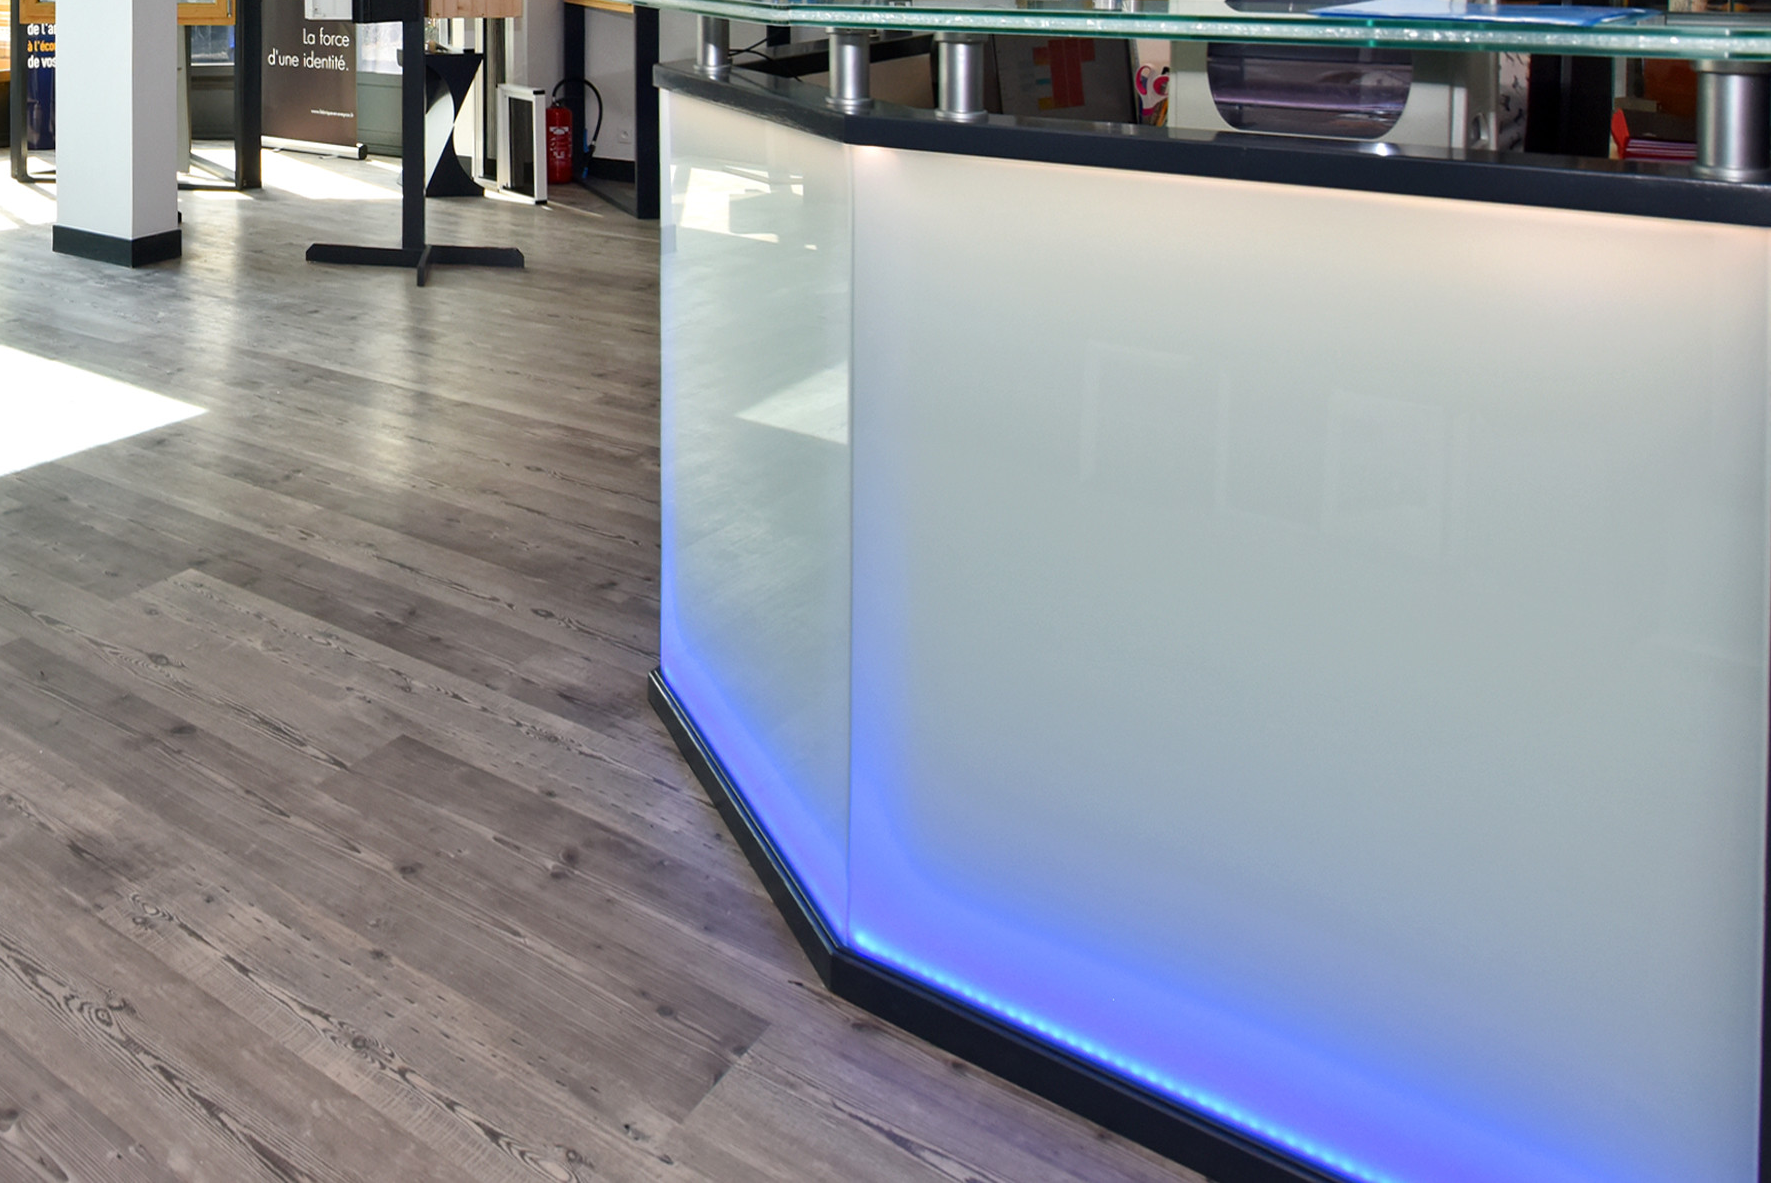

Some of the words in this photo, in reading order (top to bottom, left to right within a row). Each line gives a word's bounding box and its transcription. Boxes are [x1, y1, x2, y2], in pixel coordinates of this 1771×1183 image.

[27, 23, 39, 35] de
[319, 26, 350, 47] force
[27, 54, 40, 68] de
[267, 47, 299, 67] d'une
[303, 50, 350, 71] identité.
